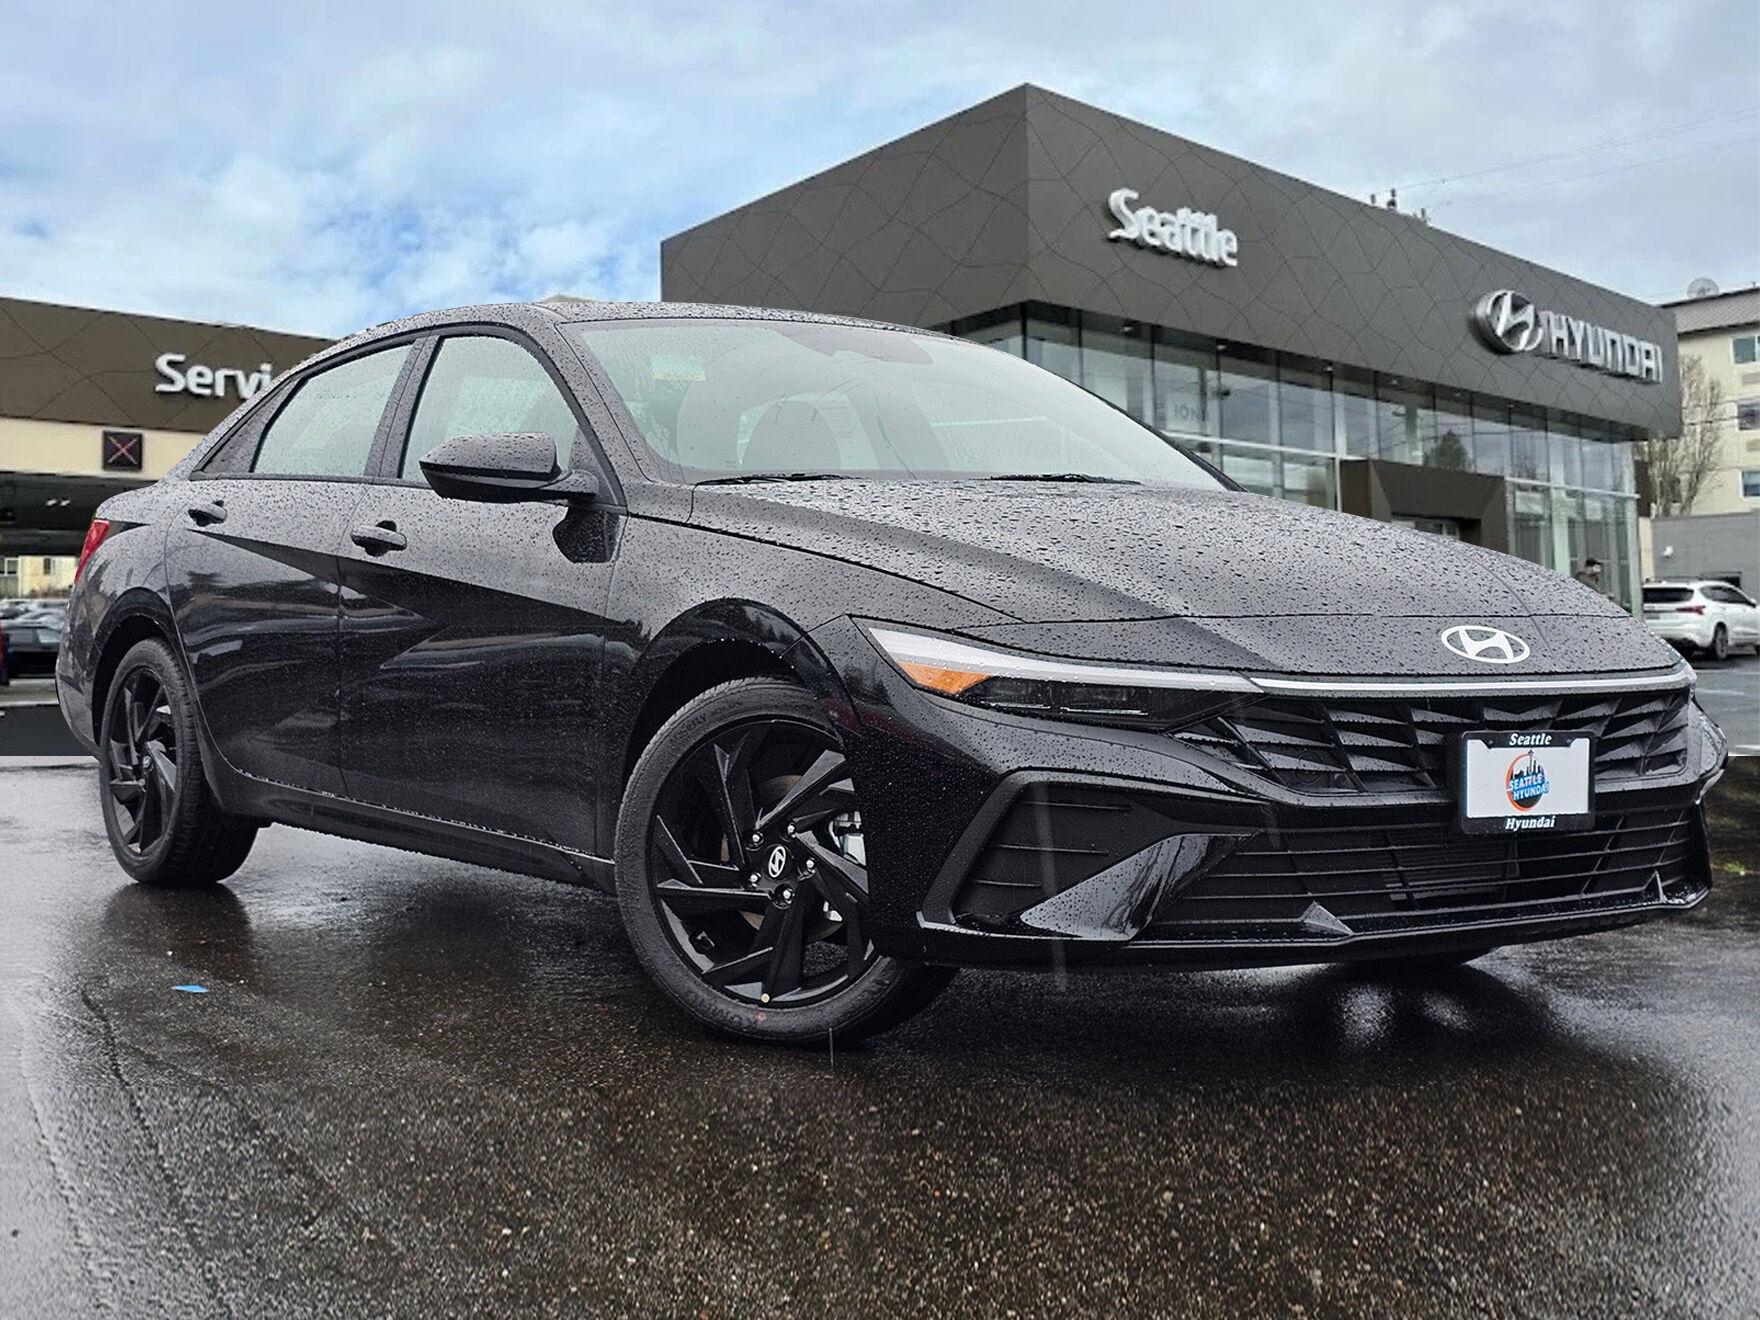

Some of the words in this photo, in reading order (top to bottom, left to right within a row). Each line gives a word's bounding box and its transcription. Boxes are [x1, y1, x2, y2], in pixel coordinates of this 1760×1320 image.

[1108, 188, 1238, 266] Seattle
[1541, 310, 1663, 383] HYUNDAI
[1509, 733, 1552, 746] Seattle
[1508, 773, 1543, 790] SEATTLE
[1514, 781, 1550, 801] HYUNDAI
[1505, 816, 1555, 831] Hyundai
